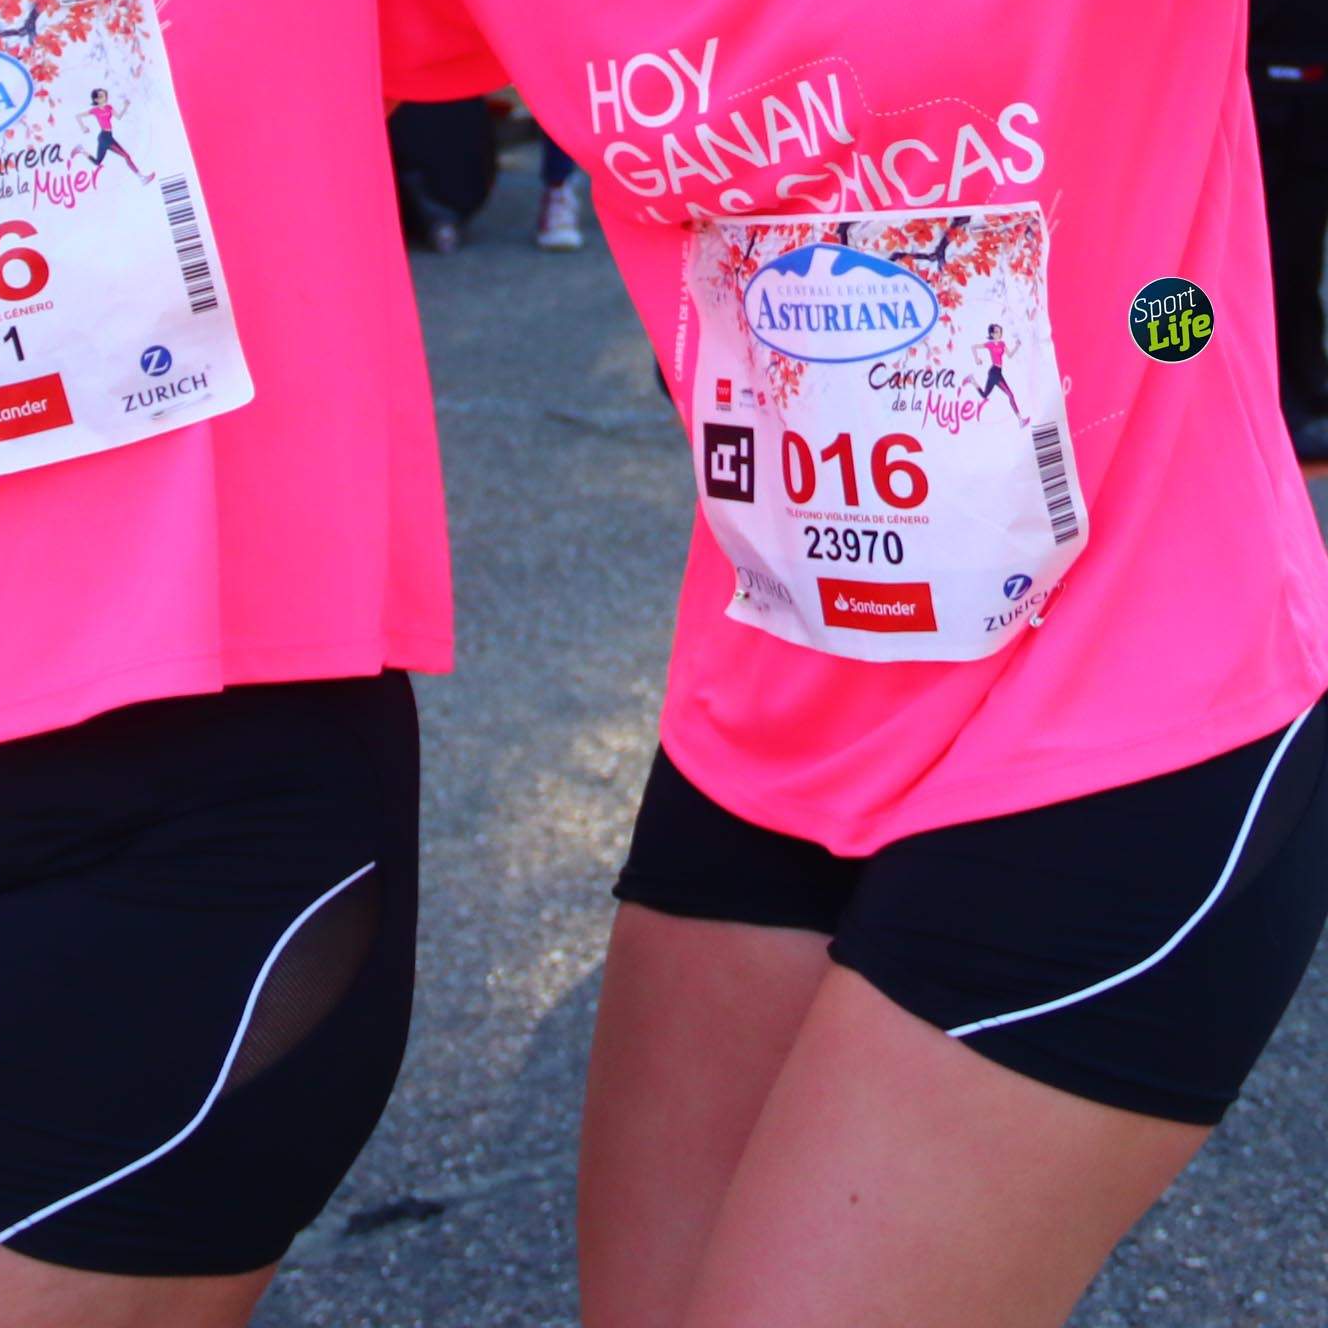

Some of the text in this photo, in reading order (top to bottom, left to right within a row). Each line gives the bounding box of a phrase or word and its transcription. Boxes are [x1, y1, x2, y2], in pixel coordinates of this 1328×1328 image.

[586, 37, 718, 134] HOY
[603, 73, 854, 197] GANAN
[776, 102, 1044, 213] CHICAS
[17, 174, 31, 195] la
[33, 160, 104, 211] Mujer
[4, 300, 55, 321] GÉNERO
[756, 288, 921, 332] ASTURIANA
[1133, 286, 1197, 323] Sport
[1147, 309, 1212, 352] Life
[121, 372, 208, 413] ZURICH
[868, 362, 956, 390] Carrera
[891, 387, 990, 434] de la Mujer
[781, 430, 929, 509] 016
[823, 510, 871, 523] VIOLENCIA
[872, 514, 885, 524] DE
[886, 512, 930, 524] GÉNERO
[803, 526, 905, 564] 23970
[849, 599, 917, 617] Santander
